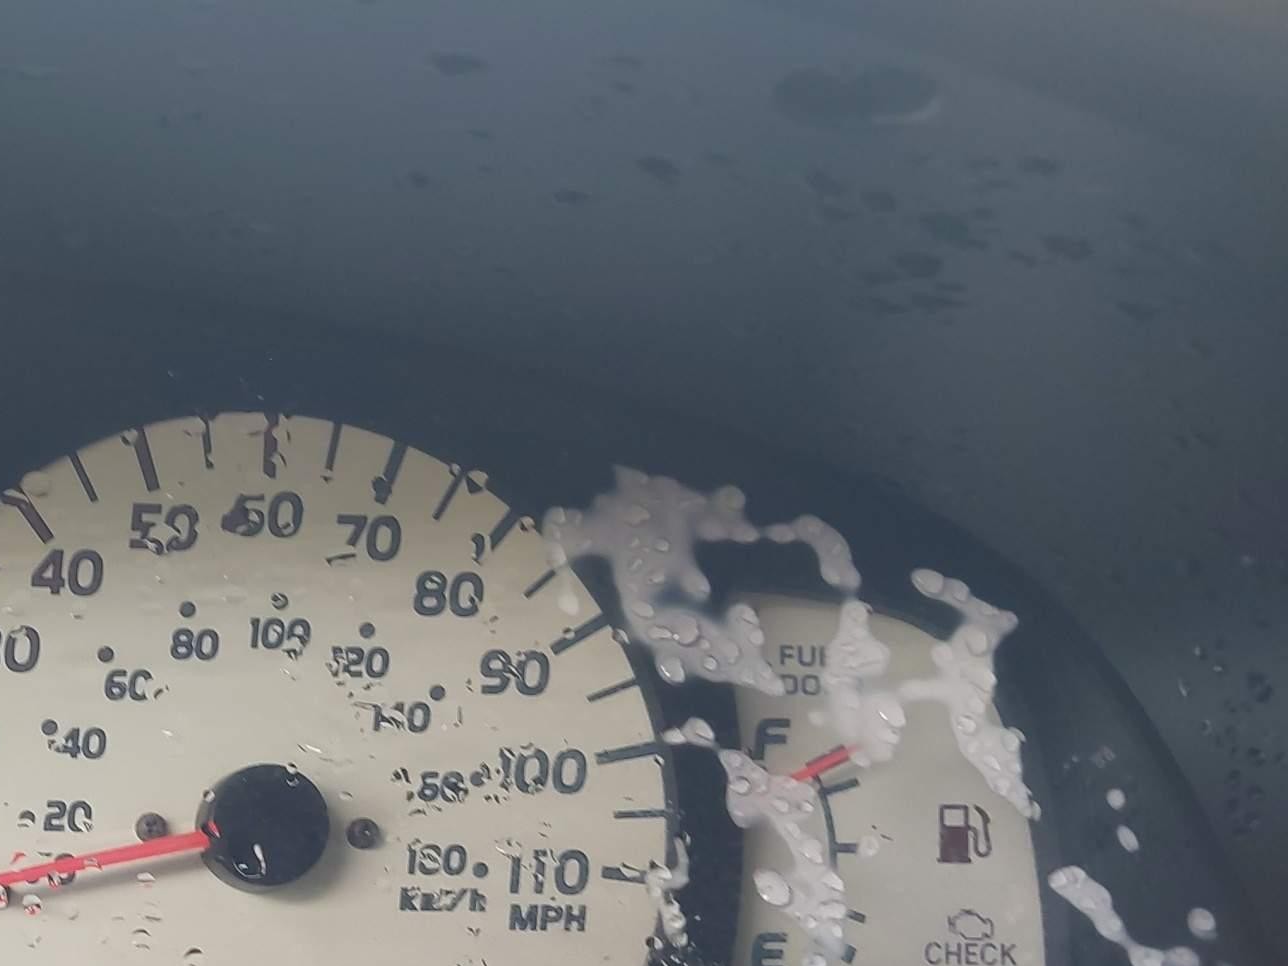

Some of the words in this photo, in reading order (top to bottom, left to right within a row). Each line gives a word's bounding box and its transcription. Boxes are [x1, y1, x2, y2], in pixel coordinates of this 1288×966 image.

[129, 503, 199, 552] 50
[336, 514, 402, 562] 70
[30, 549, 104, 596] 40
[413, 570, 484, 617] 80
[170, 628, 219, 661] 80
[249, 617, 311, 650] 100
[104, 669, 154, 701] 60
[479, 649, 550, 695] 90
[372, 702, 431, 733] 10
[60, 727, 106, 759] 40
[750, 718, 791, 761] F
[500, 747, 587, 794] 100
[43, 799, 93, 832] 20
[509, 849, 589, 895] 110
[508, 904, 587, 932] MPH
[924, 942, 1017, 966] CHECK
